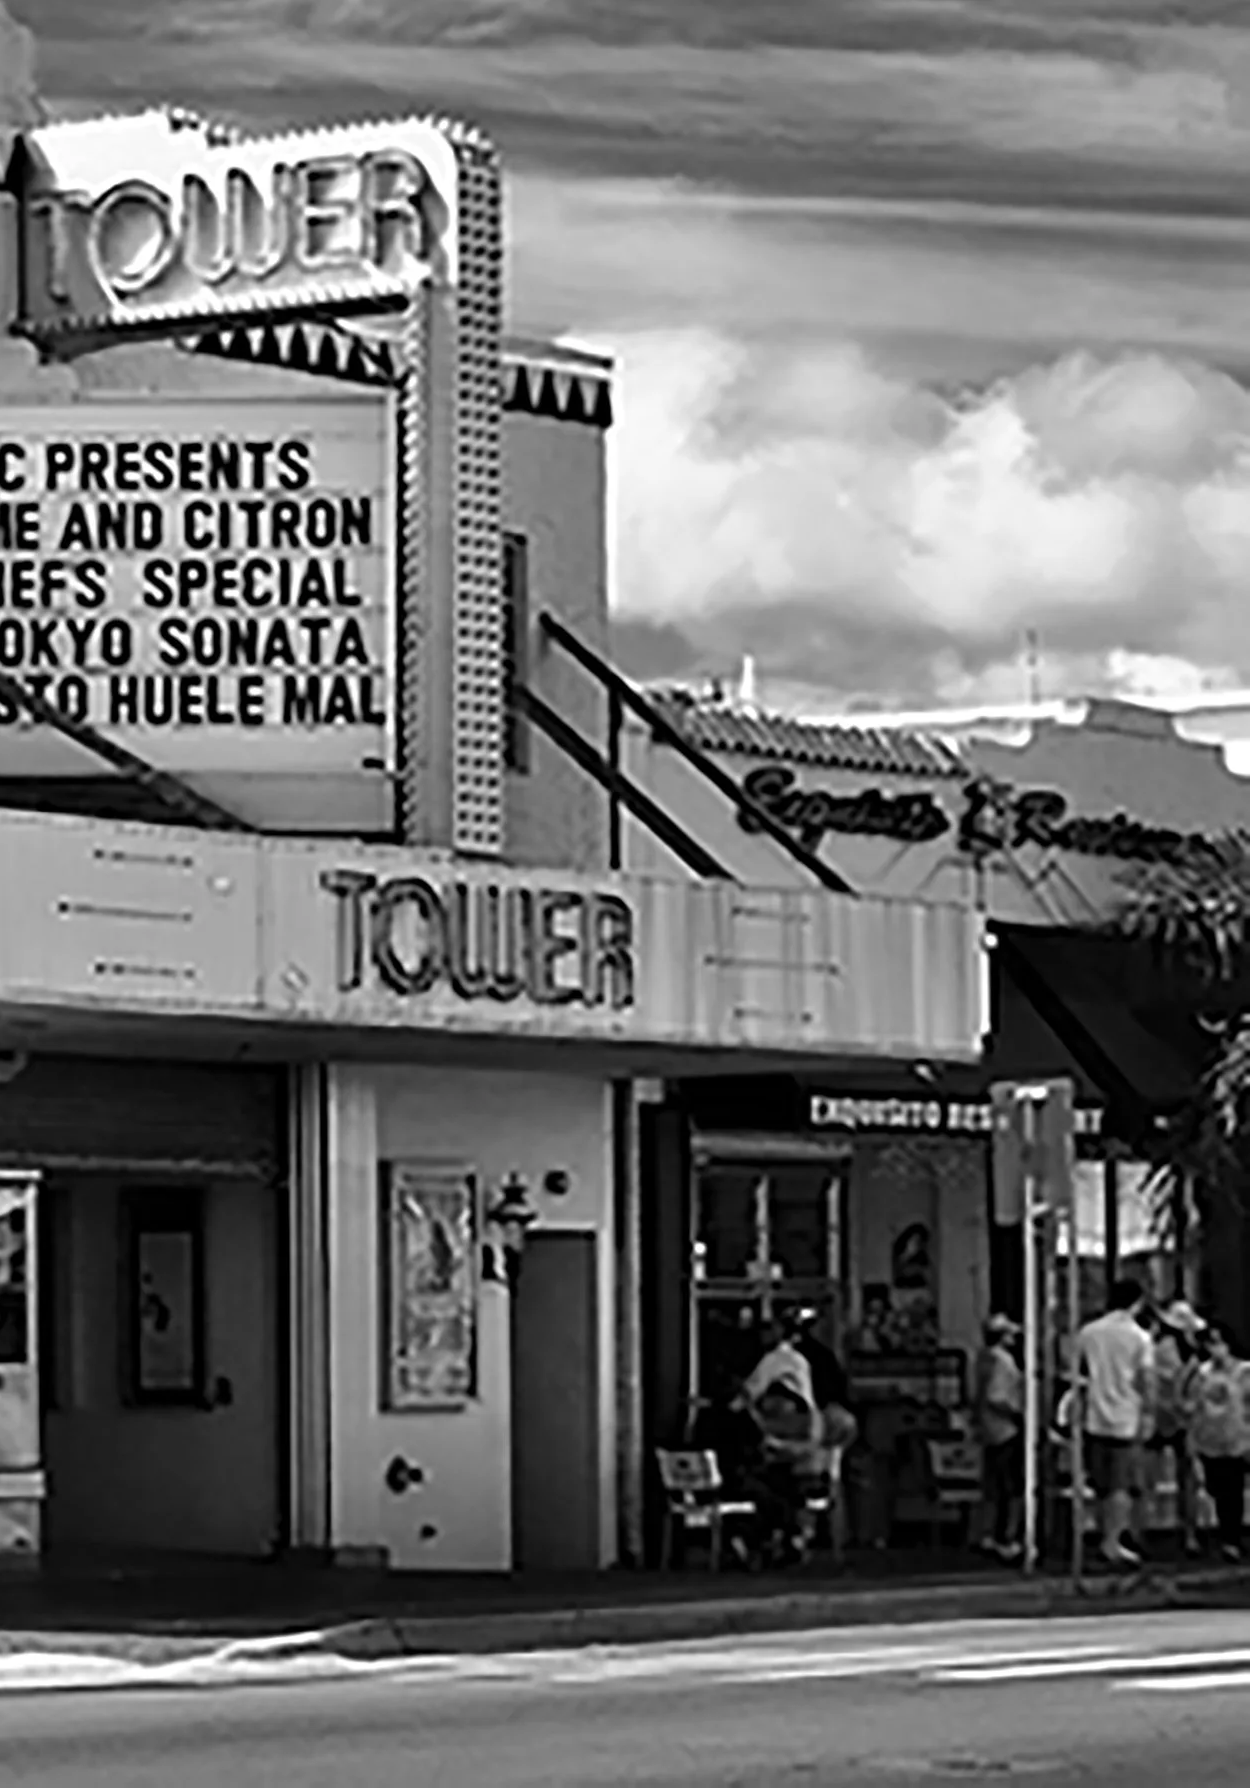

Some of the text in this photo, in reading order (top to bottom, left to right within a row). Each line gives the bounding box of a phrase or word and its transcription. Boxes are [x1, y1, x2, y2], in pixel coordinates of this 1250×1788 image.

[28, 149, 428, 304] TOWER
[46, 440, 310, 491] PRESENTS
[59, 501, 163, 552] AND
[184, 496, 371, 551] CITRON
[143, 558, 362, 609] SPECIAL
[159, 617, 369, 668] SONATA
[110, 674, 264, 726] HUELE
[282, 674, 386, 726] MAL
[320, 869, 634, 1010] TOWER
